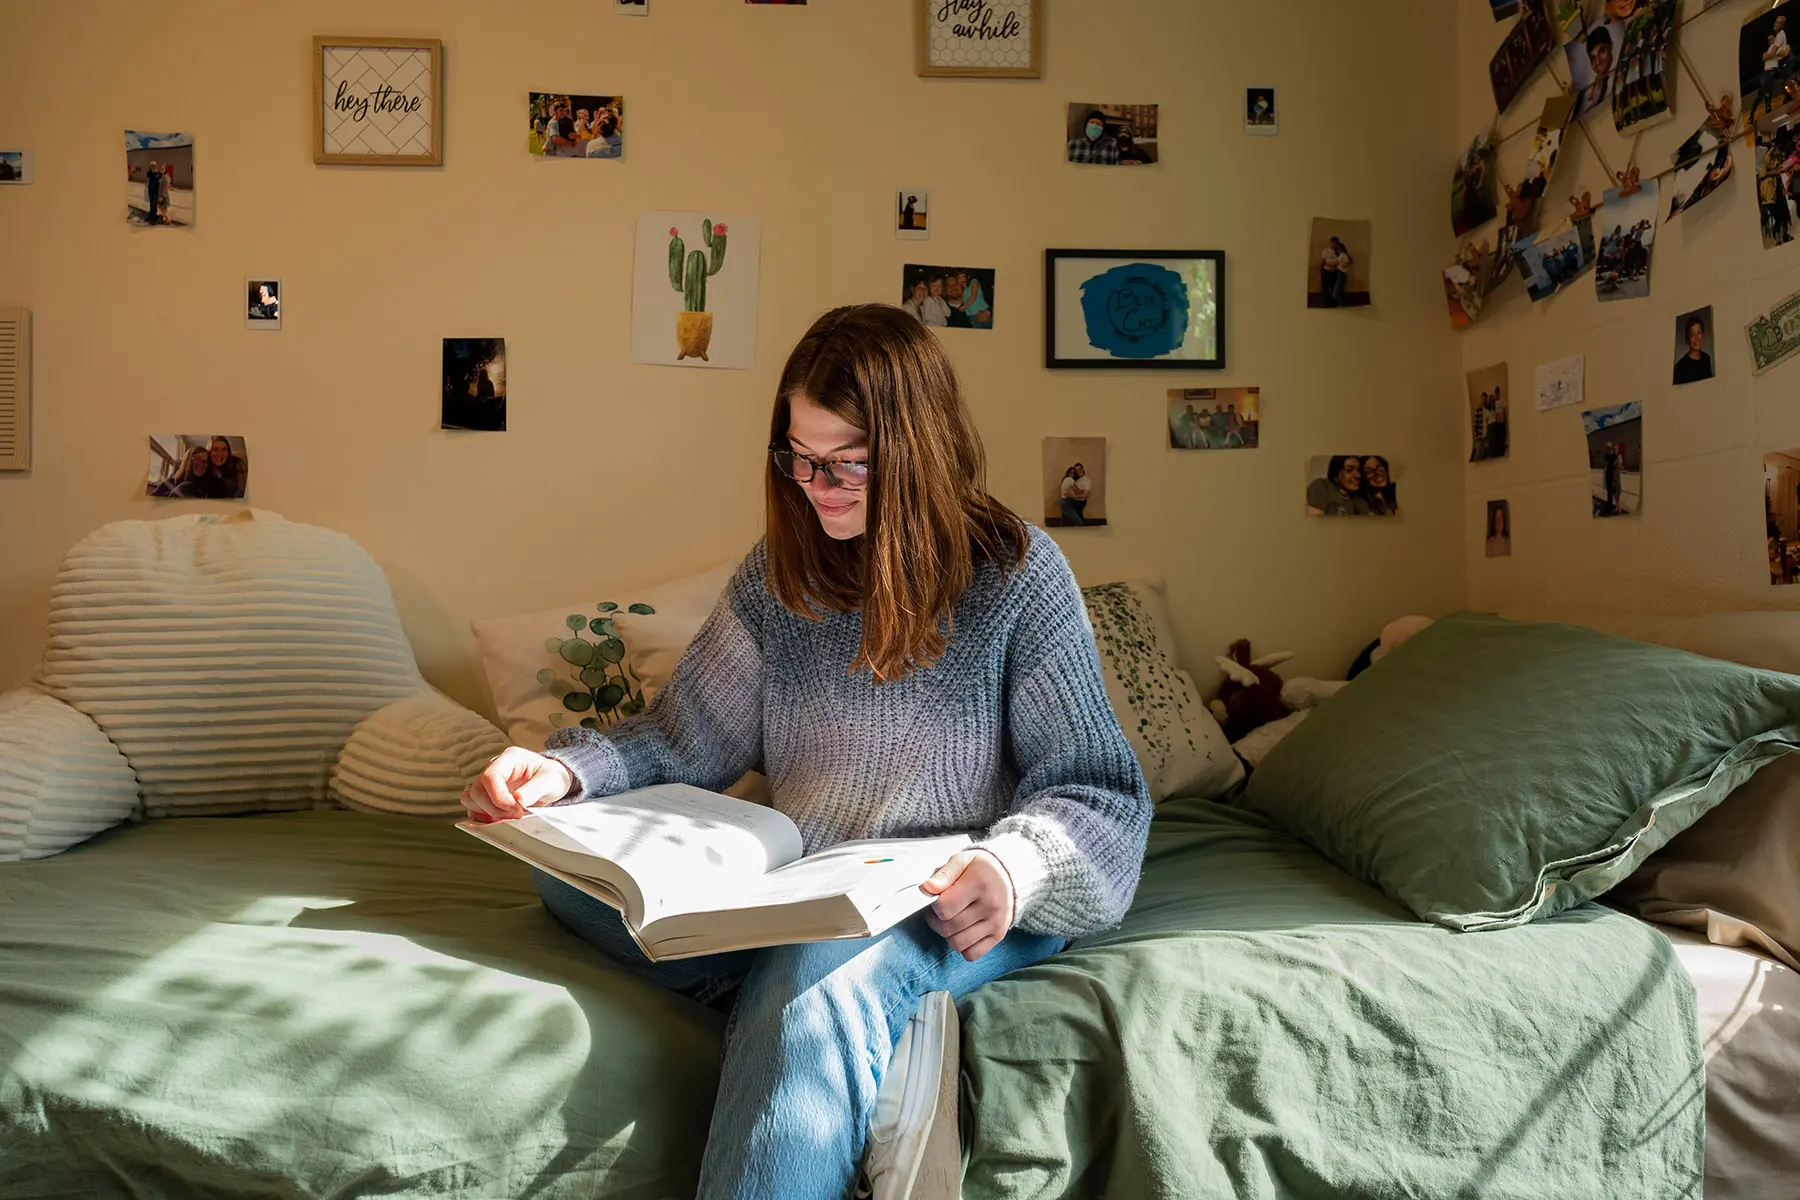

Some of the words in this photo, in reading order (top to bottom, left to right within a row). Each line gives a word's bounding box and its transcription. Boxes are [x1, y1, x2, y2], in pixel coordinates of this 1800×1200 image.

[952, 8, 1020, 40] awhile
[334, 79, 370, 123] hey
[370, 83, 422, 114] there
